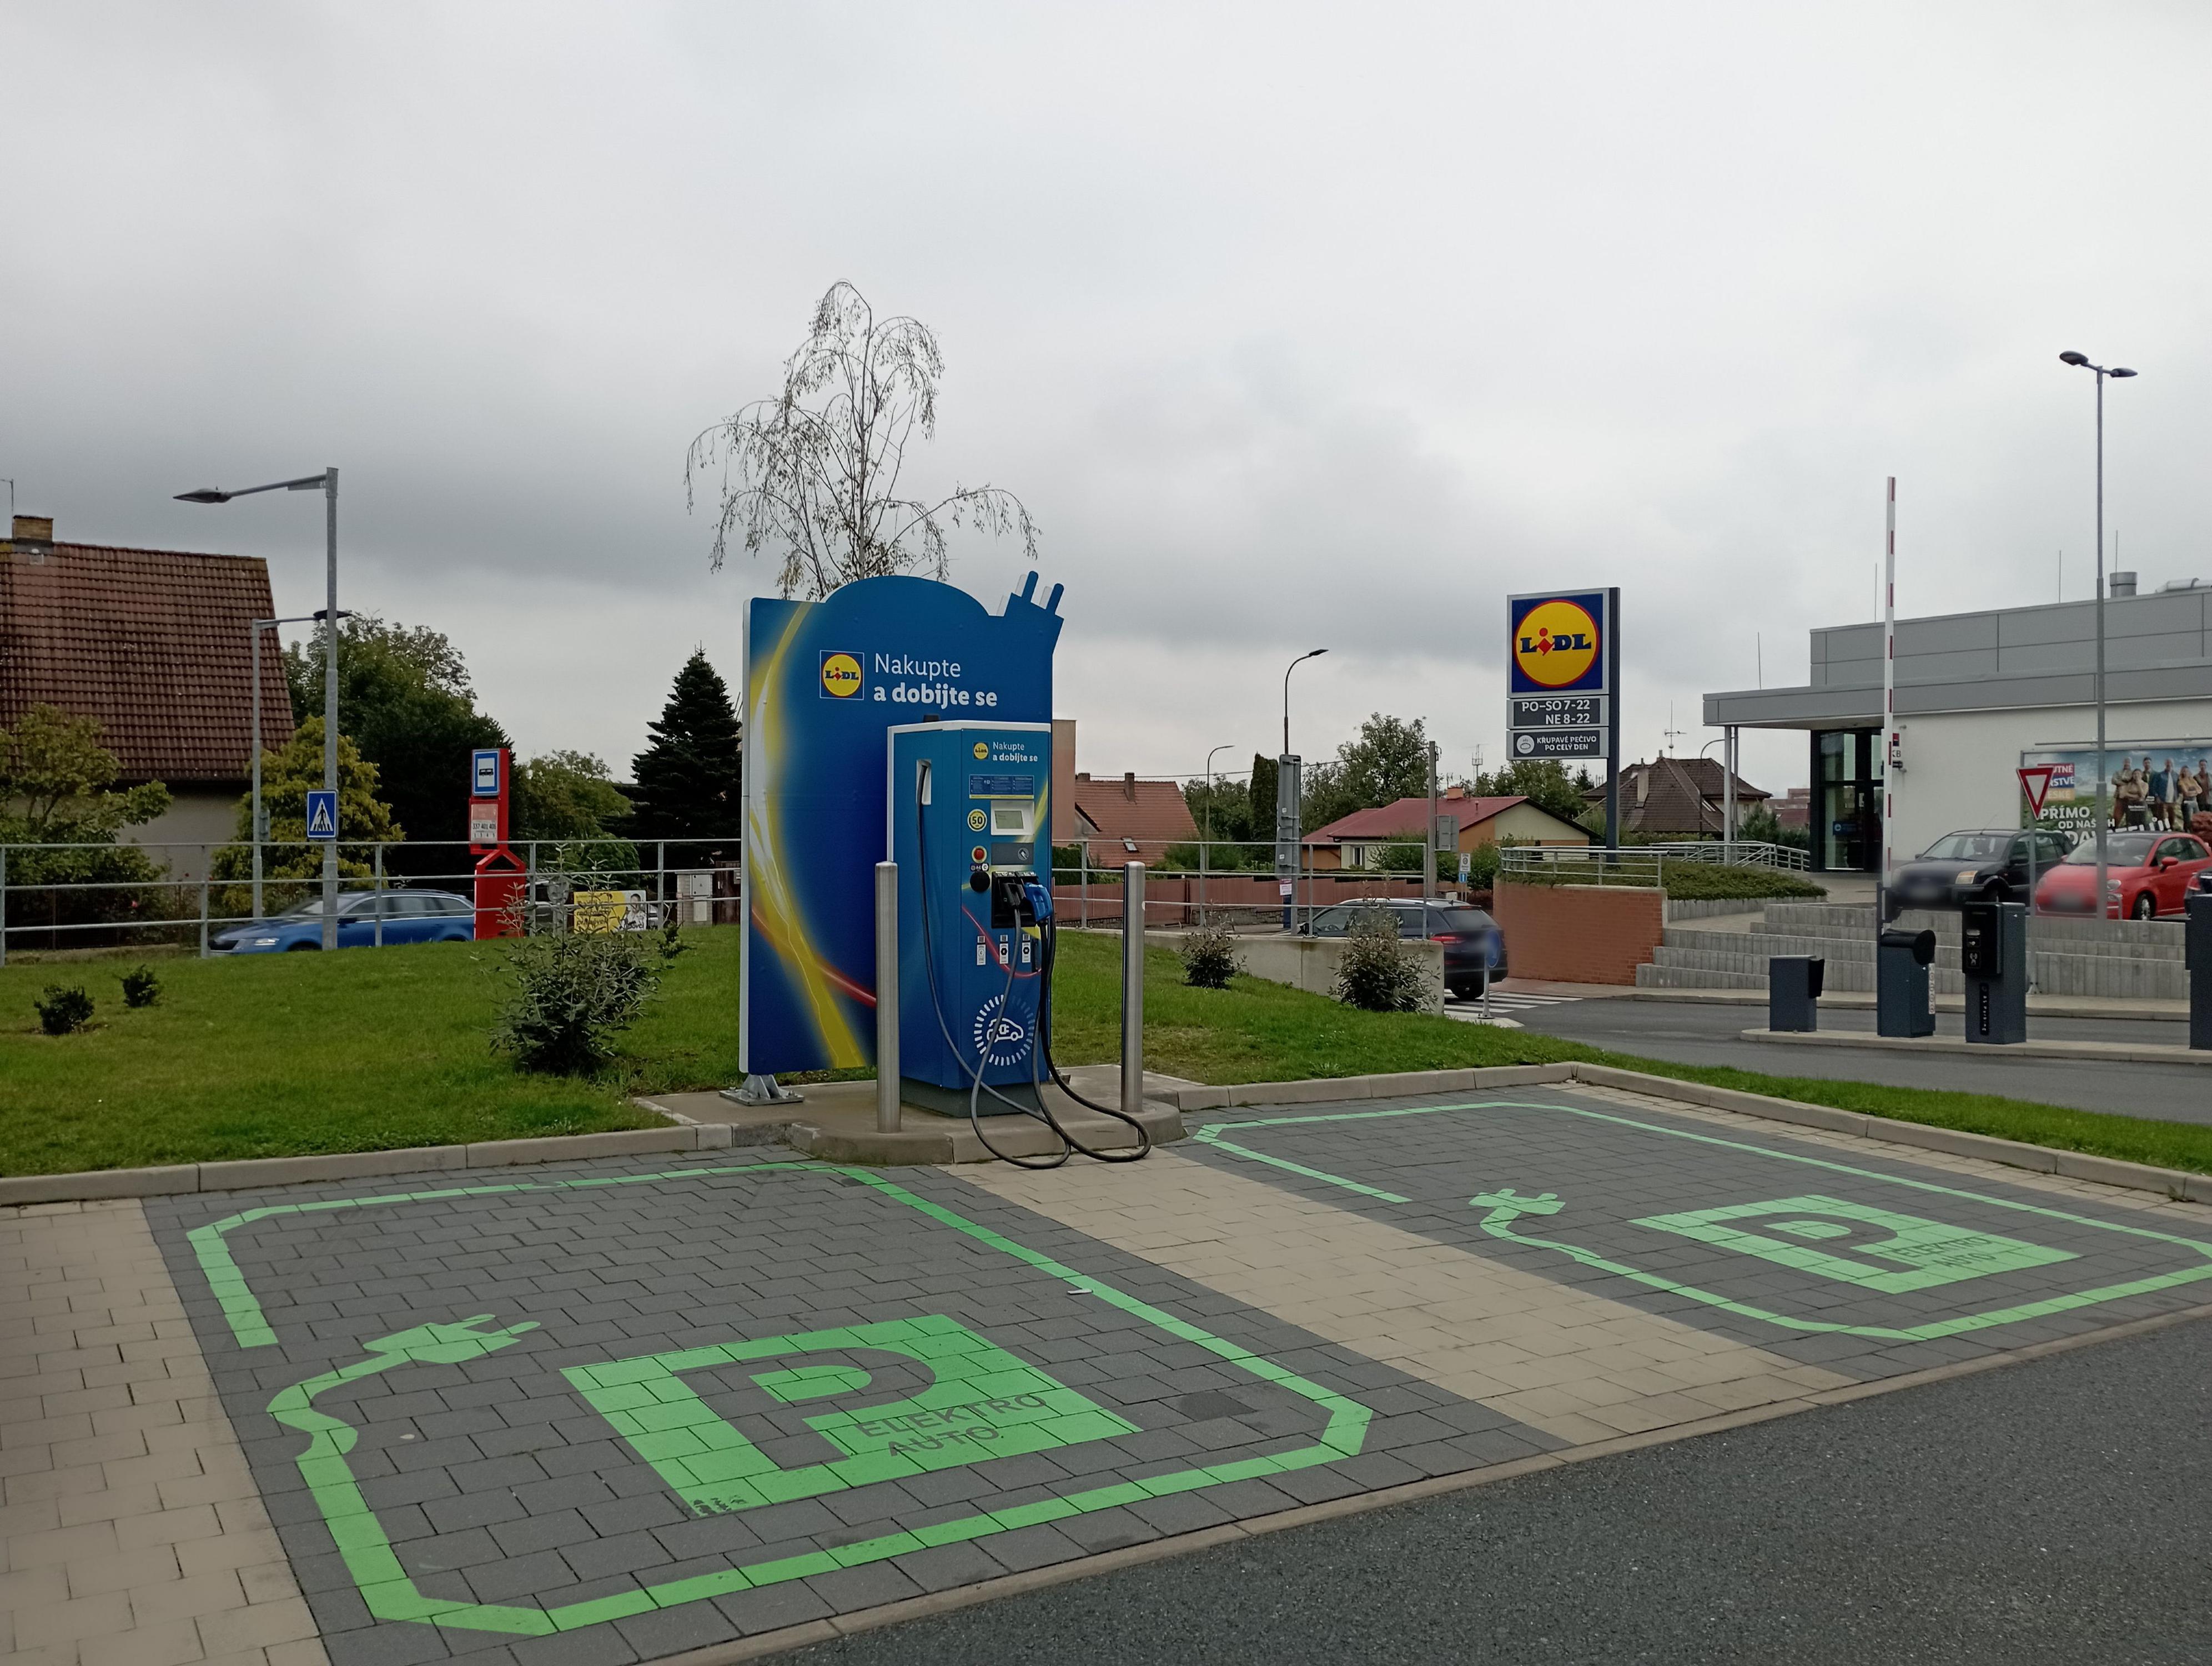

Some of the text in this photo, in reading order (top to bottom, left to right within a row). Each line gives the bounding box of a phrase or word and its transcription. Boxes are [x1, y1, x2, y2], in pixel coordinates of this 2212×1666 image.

[875, 653, 961, 681] Nakupte
[874, 682, 997, 709] a dobijte se
[1564, 700, 1590, 710] 7-22
[1546, 714, 1590, 725] NE 8-22
[993, 742, 1025, 751] Nakupte
[999, 753, 1028, 763] dobijte
[2040, 805, 2090, 819] PŘÍMO
[972, 816, 983, 825] 50
[2058, 821, 2073, 829] OD
[1892, 1237, 1992, 1258] ELEKTRO
[1932, 1253, 1997, 1267] AUTO
[854, 1394, 1047, 1437] ELEKTRO
[888, 1426, 999, 1456] AUTO
